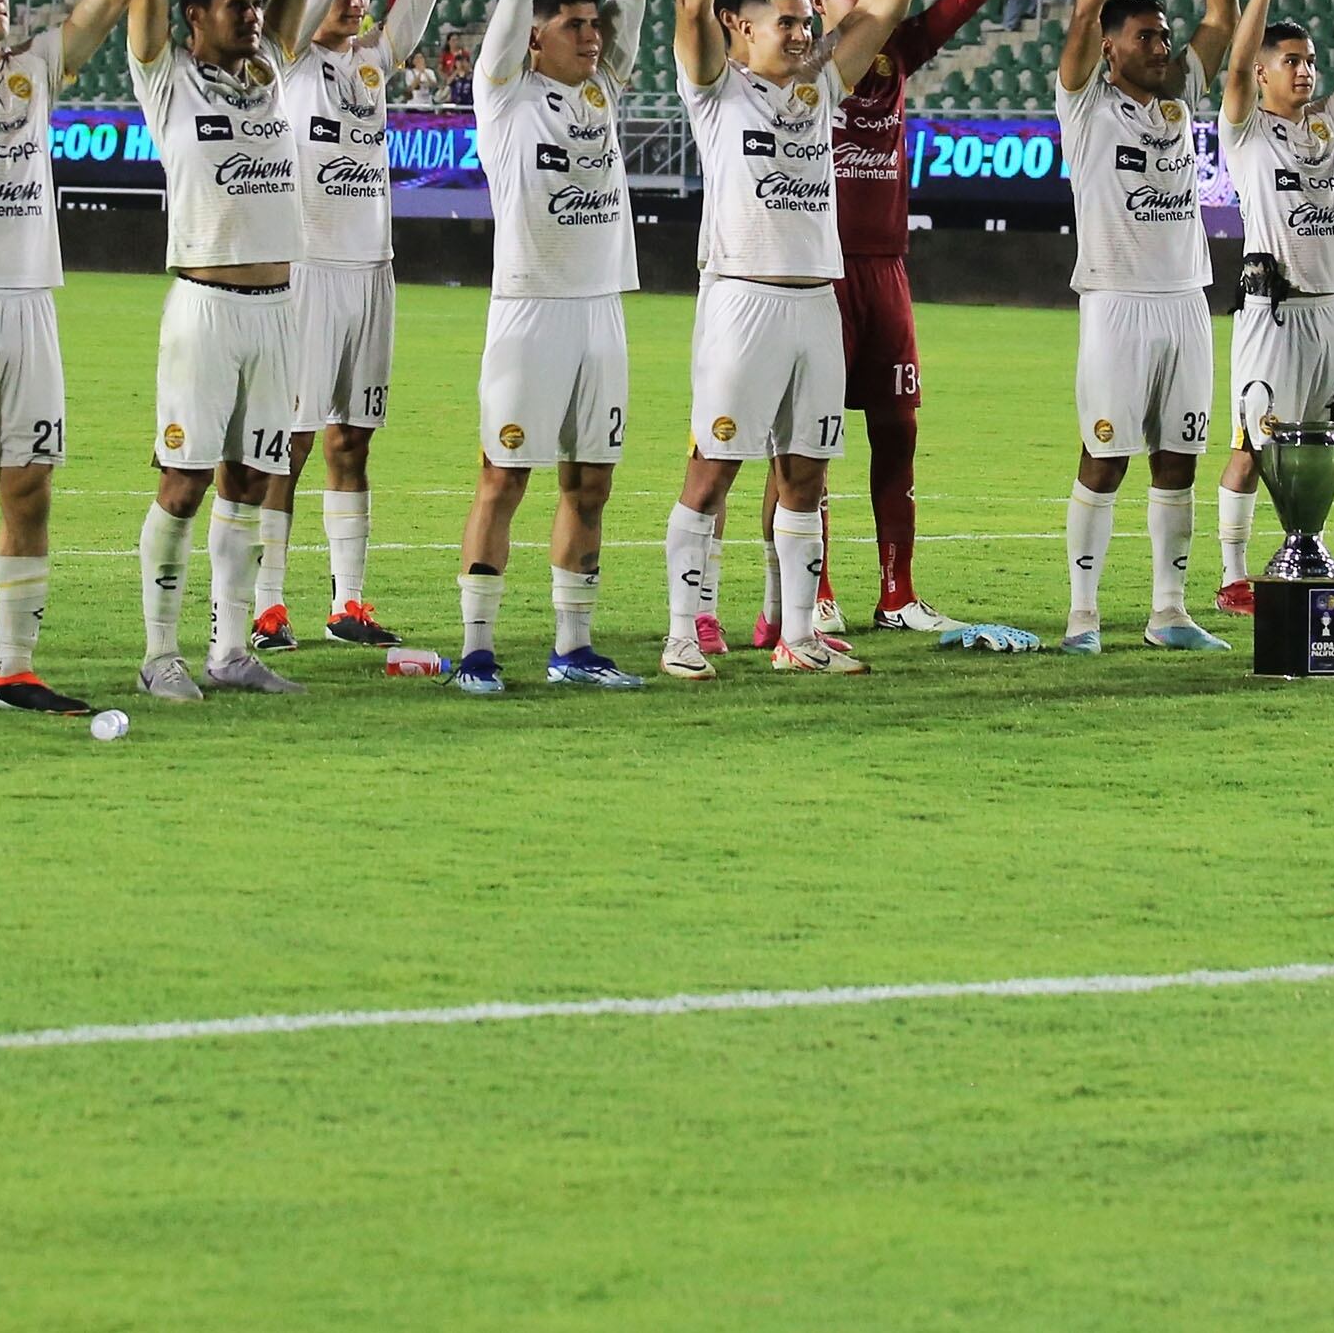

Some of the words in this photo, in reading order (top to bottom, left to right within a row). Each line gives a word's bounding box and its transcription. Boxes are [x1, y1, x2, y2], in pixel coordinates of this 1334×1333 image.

[240, 120, 292, 142] Coppe
[929, 134, 1055, 179] 20:00
[764, 197, 831, 213] caliente.m
[893, 363, 917, 395] 13
[32, 418, 63, 454] 21
[609, 406, 622, 448] 2
[817, 415, 842, 447] 17
[1181, 411, 1207, 442] 32
[252, 427, 284, 463] 14
[1310, 641, 1334, 652] COPA
